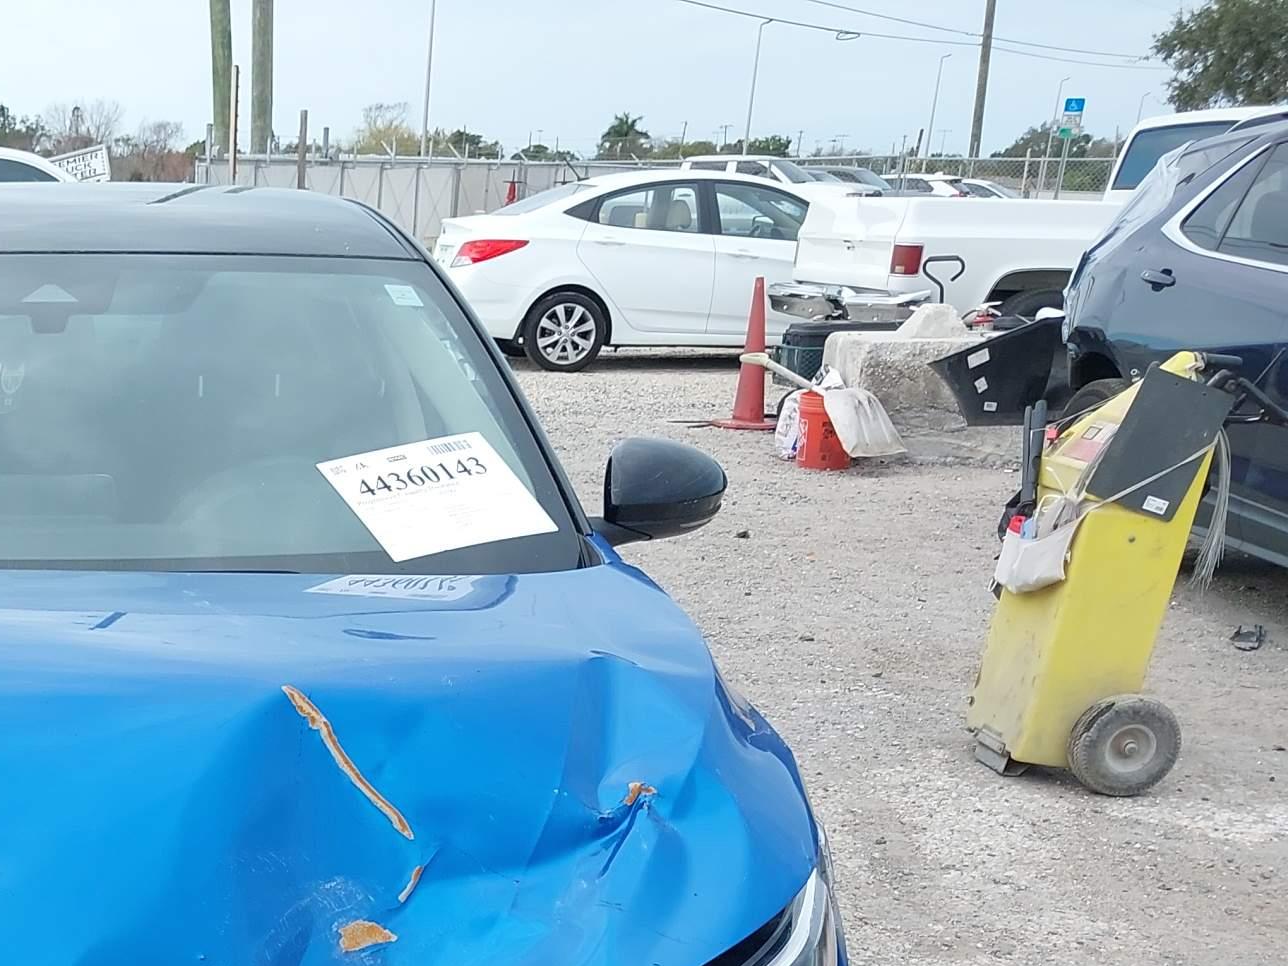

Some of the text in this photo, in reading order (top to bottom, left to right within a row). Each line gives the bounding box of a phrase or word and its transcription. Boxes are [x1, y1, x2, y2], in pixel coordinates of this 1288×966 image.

[55, 152, 99, 168] EMIER
[65, 161, 93, 174] UCK
[358, 456, 488, 497] 44360143
